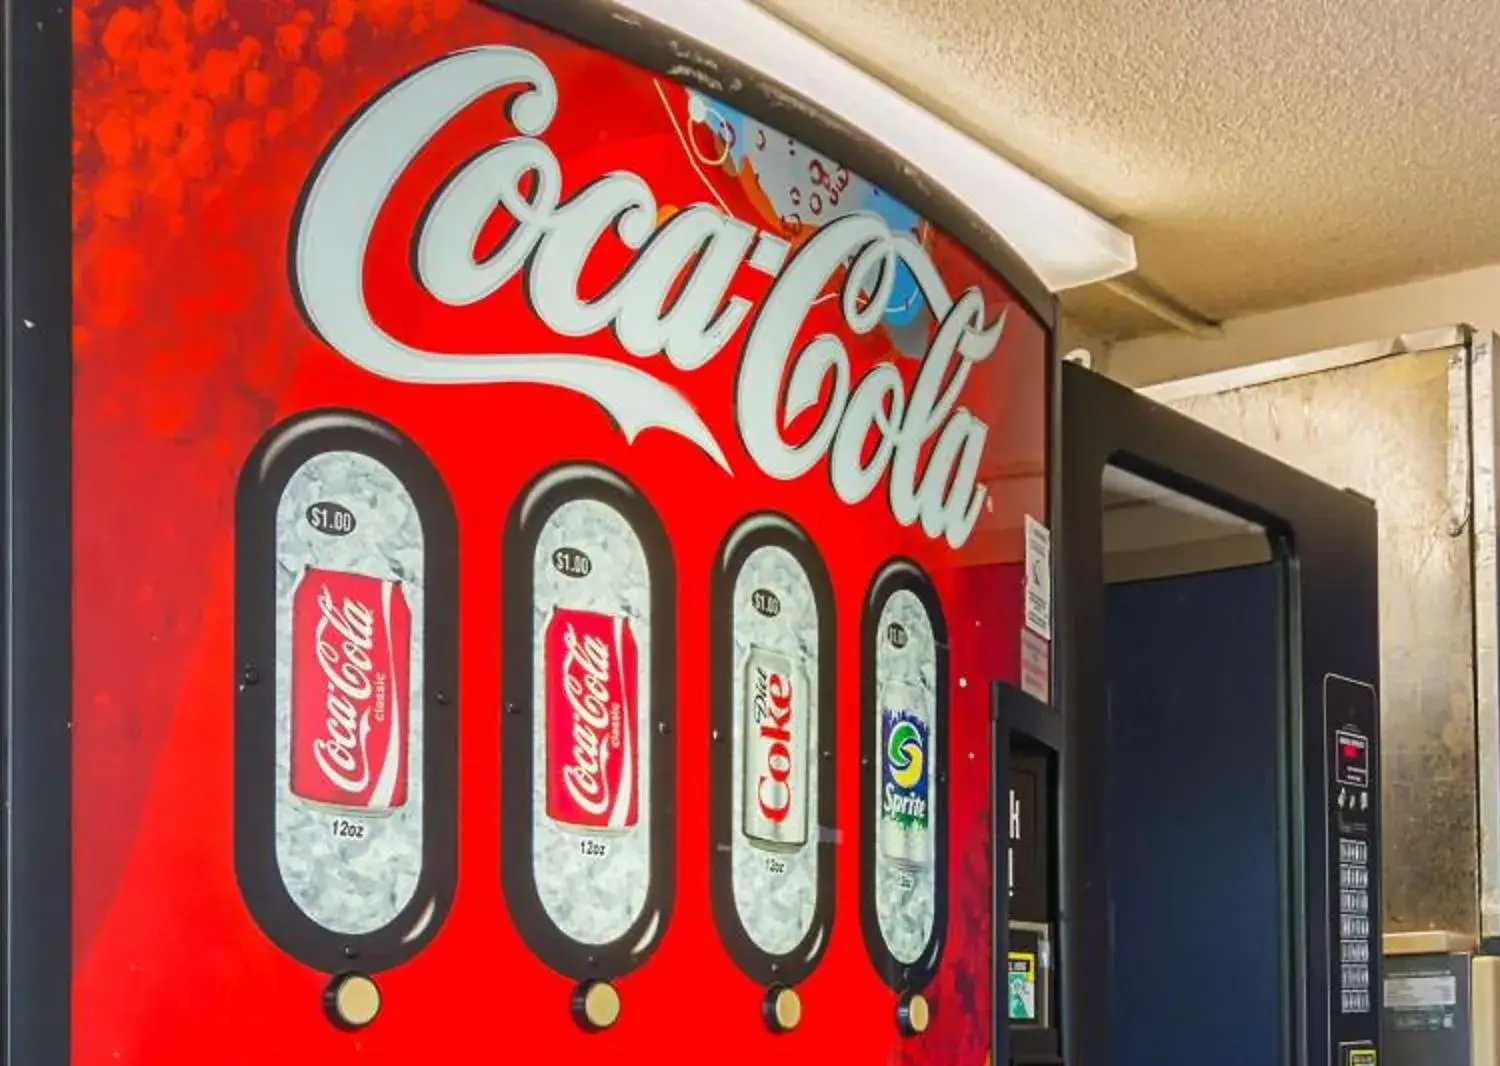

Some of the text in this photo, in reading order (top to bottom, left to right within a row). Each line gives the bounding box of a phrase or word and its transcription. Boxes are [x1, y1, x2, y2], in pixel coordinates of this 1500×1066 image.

[290, 45, 1008, 550] Coca-Cola
[309, 505, 353, 533] $1.00
[555, 551, 591, 576] $1.00
[313, 583, 376, 793] Coca-Cola
[563, 621, 610, 815] Coca-Cola
[757, 673, 793, 824] Coke
[884, 782, 927, 819] Sprite
[331, 820, 365, 838] 12oz
[580, 840, 606, 857] 12oz
